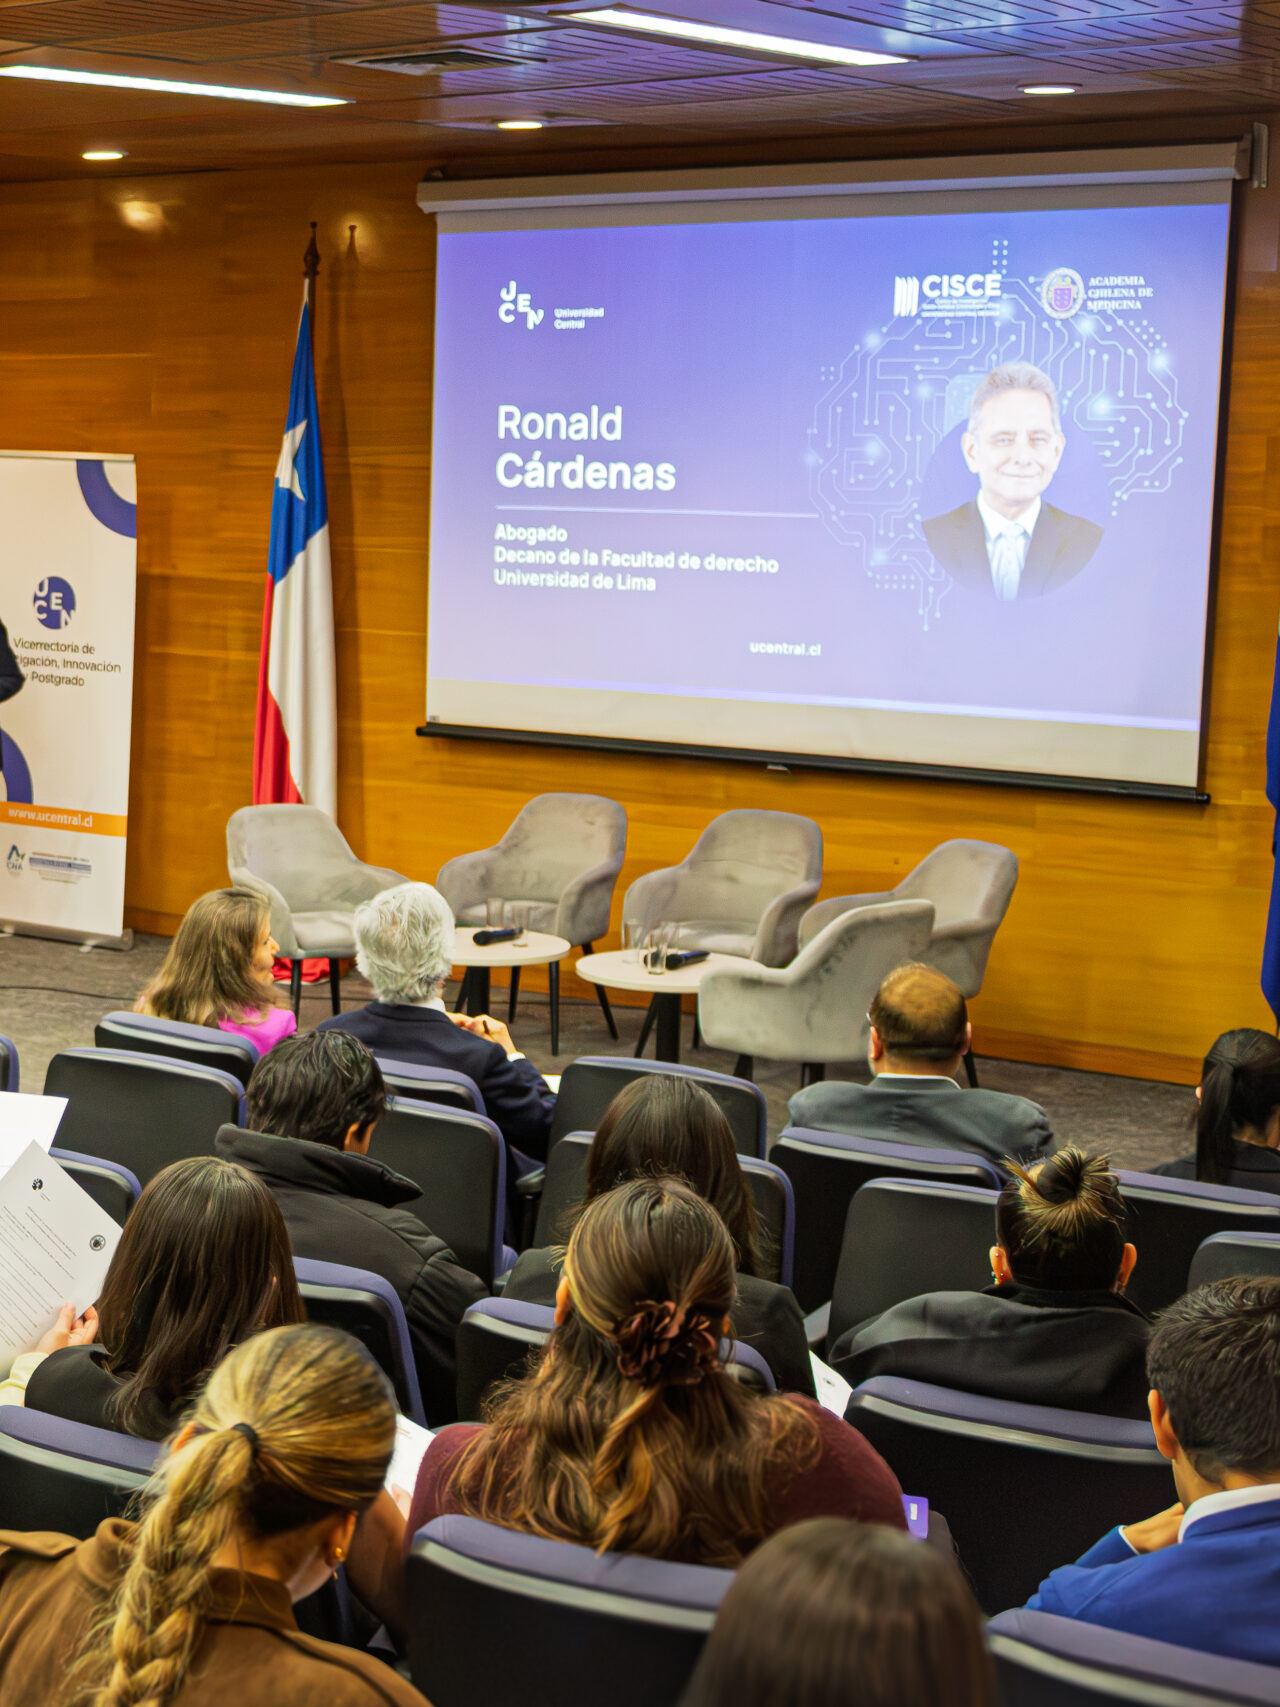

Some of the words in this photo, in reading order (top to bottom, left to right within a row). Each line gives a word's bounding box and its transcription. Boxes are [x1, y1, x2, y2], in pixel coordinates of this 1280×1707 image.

[922, 273, 1002, 298] CISCE
[497, 404, 623, 441] Ronald
[495, 450, 677, 491] Cárdenas
[494, 522, 568, 546] Abogado
[493, 545, 556, 564] Decano
[558, 547, 581, 566] de
[583, 548, 599, 566] la
[601, 549, 675, 569] Facultad
[677, 552, 701, 570] de
[703, 553, 780, 573] derecho
[493, 568, 590, 588] Universidad
[591, 571, 614, 590] de
[616, 573, 657, 591] Lima
[81, 642, 95, 654] de
[748, 641, 822, 656] ucentral.cl
[15, 654, 60, 669] igación,
[63, 658, 122, 673] Innovación
[31, 671, 85, 687] Postgrado
[8, 808, 93, 828] www.ucentral.cl
